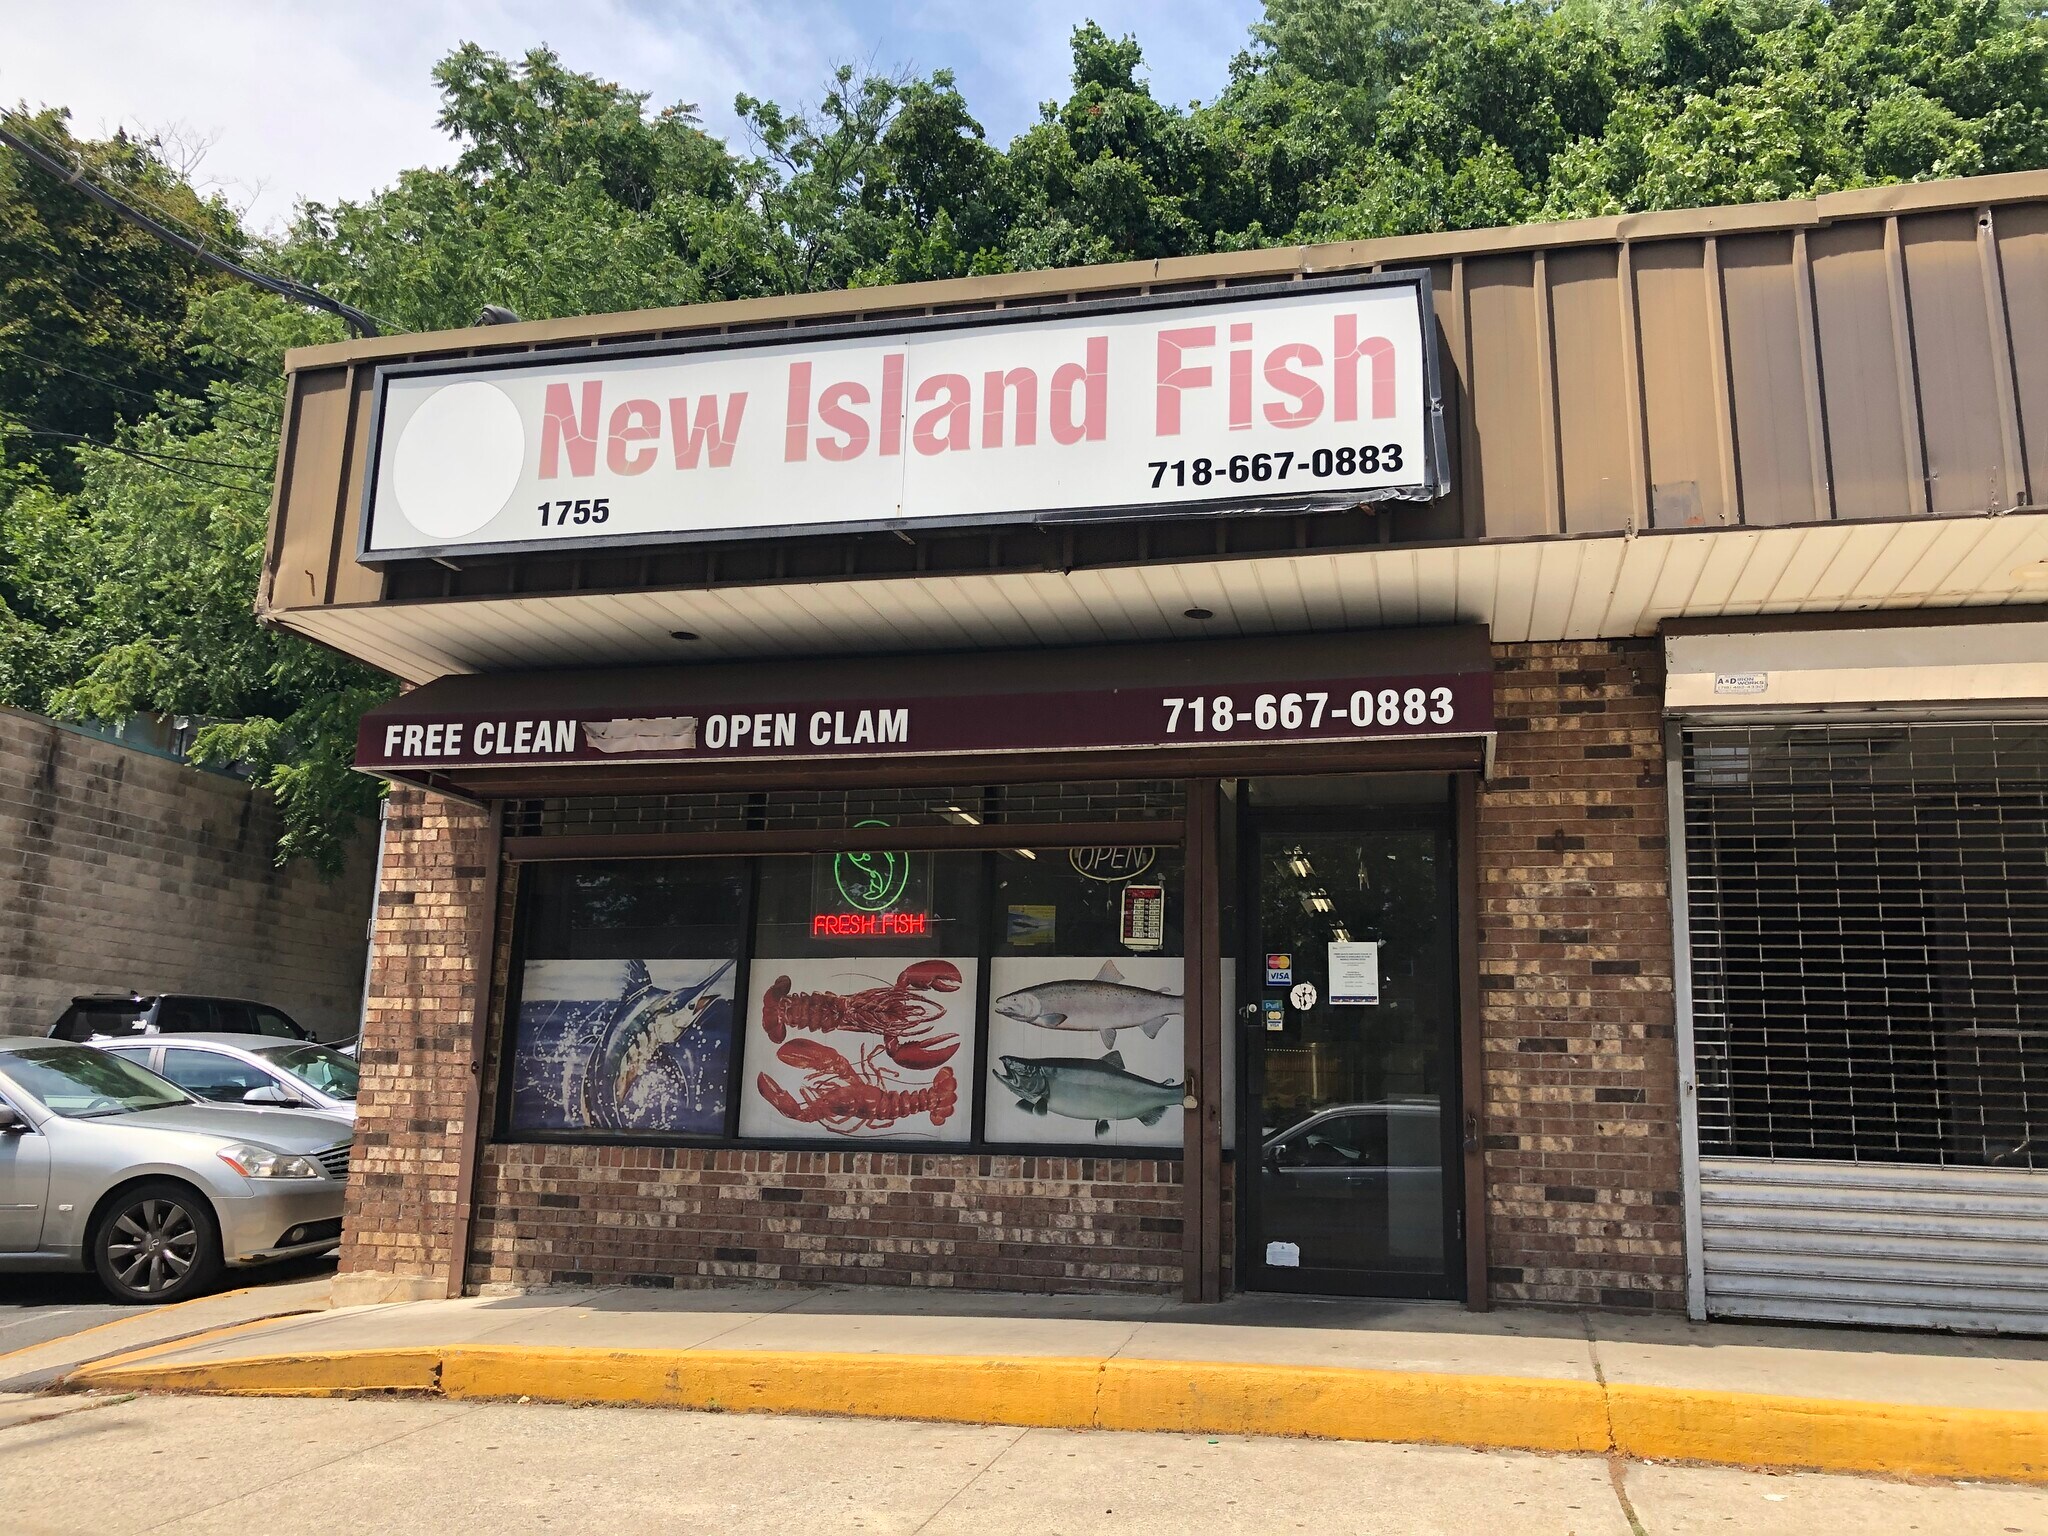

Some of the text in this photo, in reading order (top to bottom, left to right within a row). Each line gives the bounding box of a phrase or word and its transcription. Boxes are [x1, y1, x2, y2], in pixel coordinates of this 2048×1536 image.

[538, 314, 1397, 480] New Island Fish
[1148, 443, 1403, 489] 718-667-0883
[537, 498, 610, 527] 1755
[1162, 686, 1455, 733] 718-667-0883
[384, 723, 464, 757] FREE
[473, 720, 577, 756] CLEAN
[705, 713, 797, 749] OPEN
[809, 708, 909, 746] CLAM
[1078, 847, 1144, 870] OPEN
[814, 913, 925, 935] FRESH FISH
[1270, 972, 1290, 980] VISA
